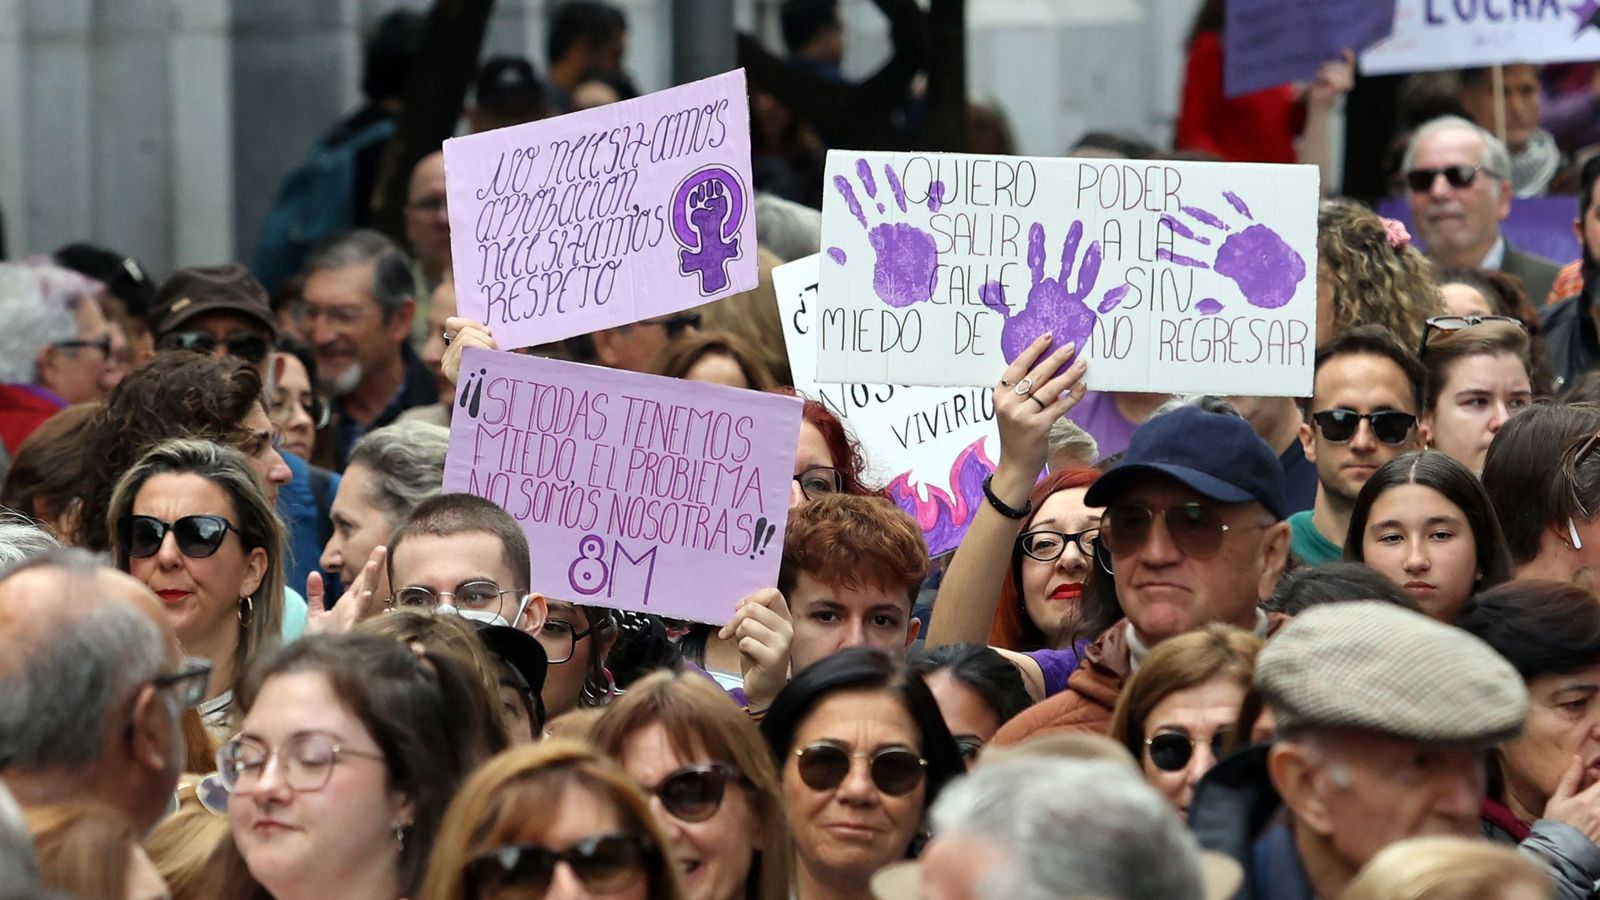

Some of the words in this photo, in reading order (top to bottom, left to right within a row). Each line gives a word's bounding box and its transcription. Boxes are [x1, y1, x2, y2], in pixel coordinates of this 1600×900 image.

[902, 156, 1037, 208] QUIERO
[1077, 163, 1182, 212] PODER
[929, 212, 1021, 257] SALIR
[1102, 218, 1122, 262] A
[1138, 218, 1174, 262] LA
[480, 258, 623, 327] RESPETO
[928, 262, 1018, 307] CALLE
[1122, 266, 1194, 312] SIN
[822, 307, 922, 353] MIEDO
[954, 310, 989, 356] DE
[1091, 315, 1133, 360] NO
[1159, 315, 1309, 366] REGRESAR
[527, 381, 609, 441] TODAS
[621, 395, 754, 462] TENEMOS
[469, 468, 510, 512] NO
[514, 478, 601, 531] SOMOS
[473, 423, 577, 488] MIEDO,
[588, 443, 618, 491] EL
[624, 448, 764, 514] PROBLEMA
[568, 534, 659, 605] 8M
